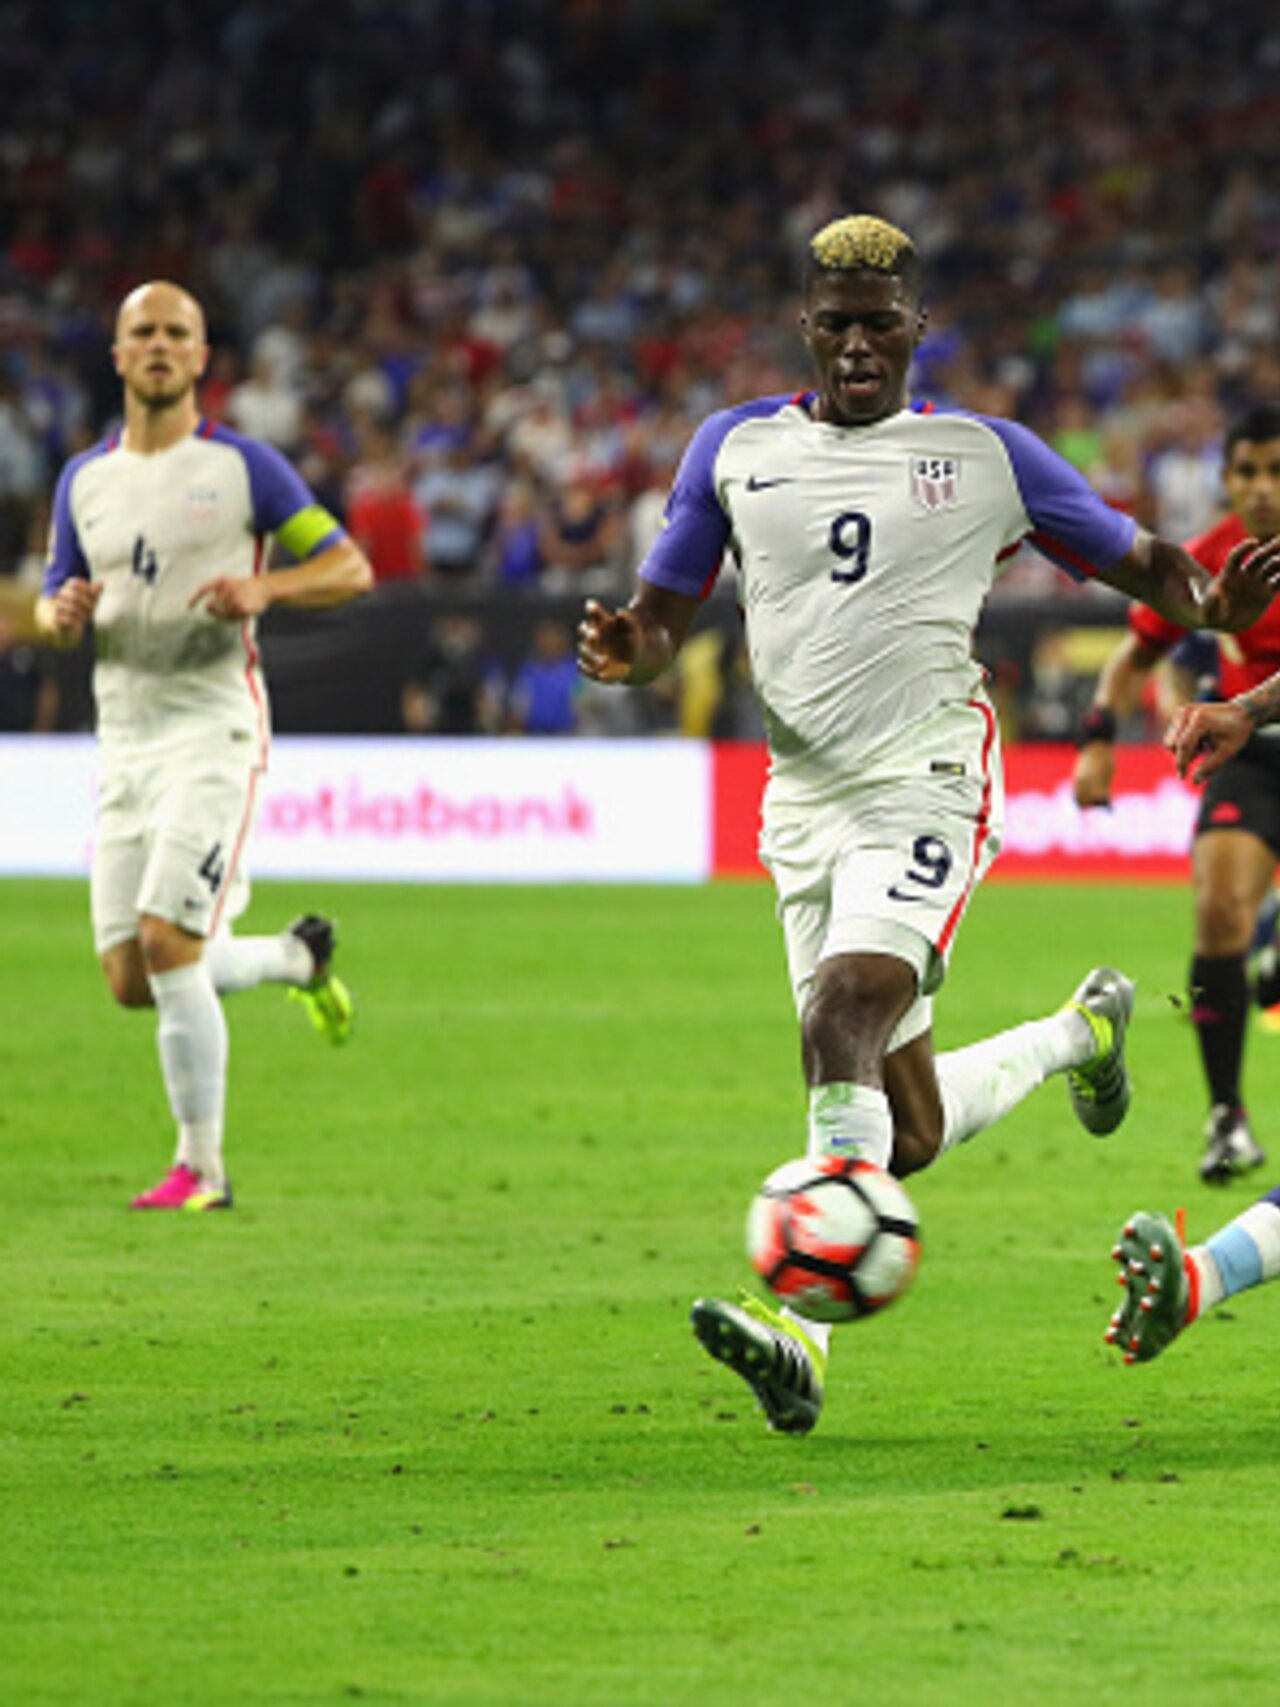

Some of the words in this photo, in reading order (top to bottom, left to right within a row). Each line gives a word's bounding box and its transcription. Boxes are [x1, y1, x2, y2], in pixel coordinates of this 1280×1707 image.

[132, 532, 158, 588] 4
[829, 511, 873, 585] 9
[258, 770, 594, 837] otiabank
[198, 840, 223, 893] 4
[904, 834, 953, 889] 9
